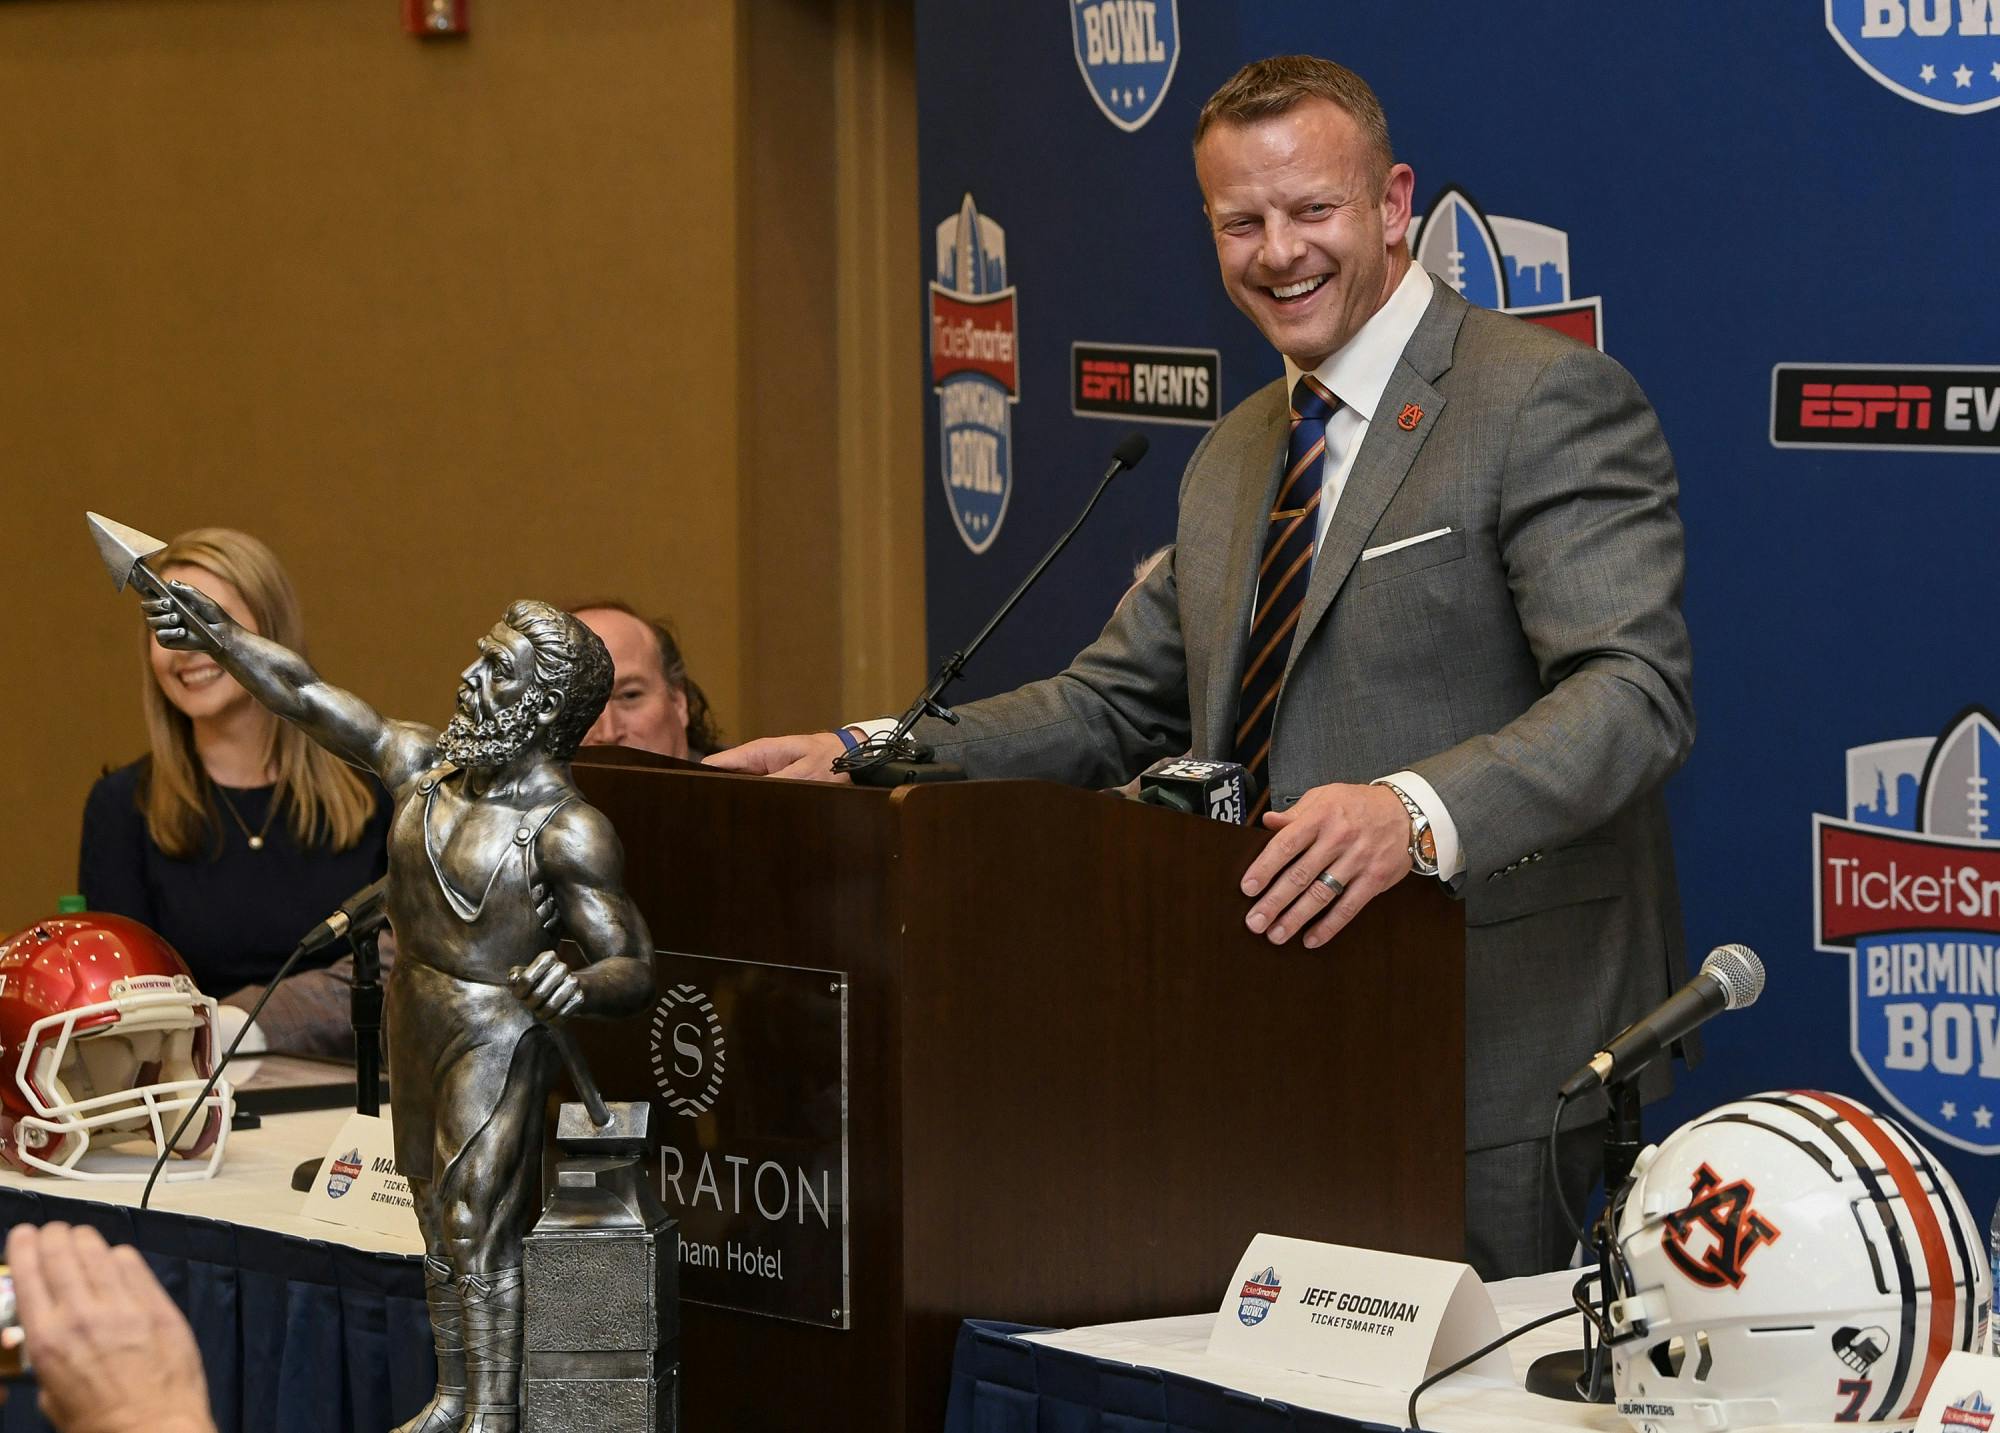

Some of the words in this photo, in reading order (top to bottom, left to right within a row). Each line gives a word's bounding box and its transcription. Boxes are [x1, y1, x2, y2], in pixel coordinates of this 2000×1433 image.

[1083, 0, 1165, 65] BOWL
[1133, 363, 1209, 408] EVENTS
[1800, 384, 1931, 430] ESPN
[950, 429, 1002, 493] BOWL
[1867, 942, 2000, 998] BIRMIN
[673, 1022, 703, 1078] S
[677, 1232, 720, 1268] ham
[727, 1240, 783, 1281] Hotel
[1241, 1305, 1264, 1318] BOWL
[1299, 1287, 1338, 1309] JEFF
[1336, 1292, 1420, 1324] GOODMAN
[1310, 1312, 1395, 1337] TICKETSMARTER
[1645, 1404, 1675, 1417] TIGERS
[1834, 1378, 1873, 1423] 7
